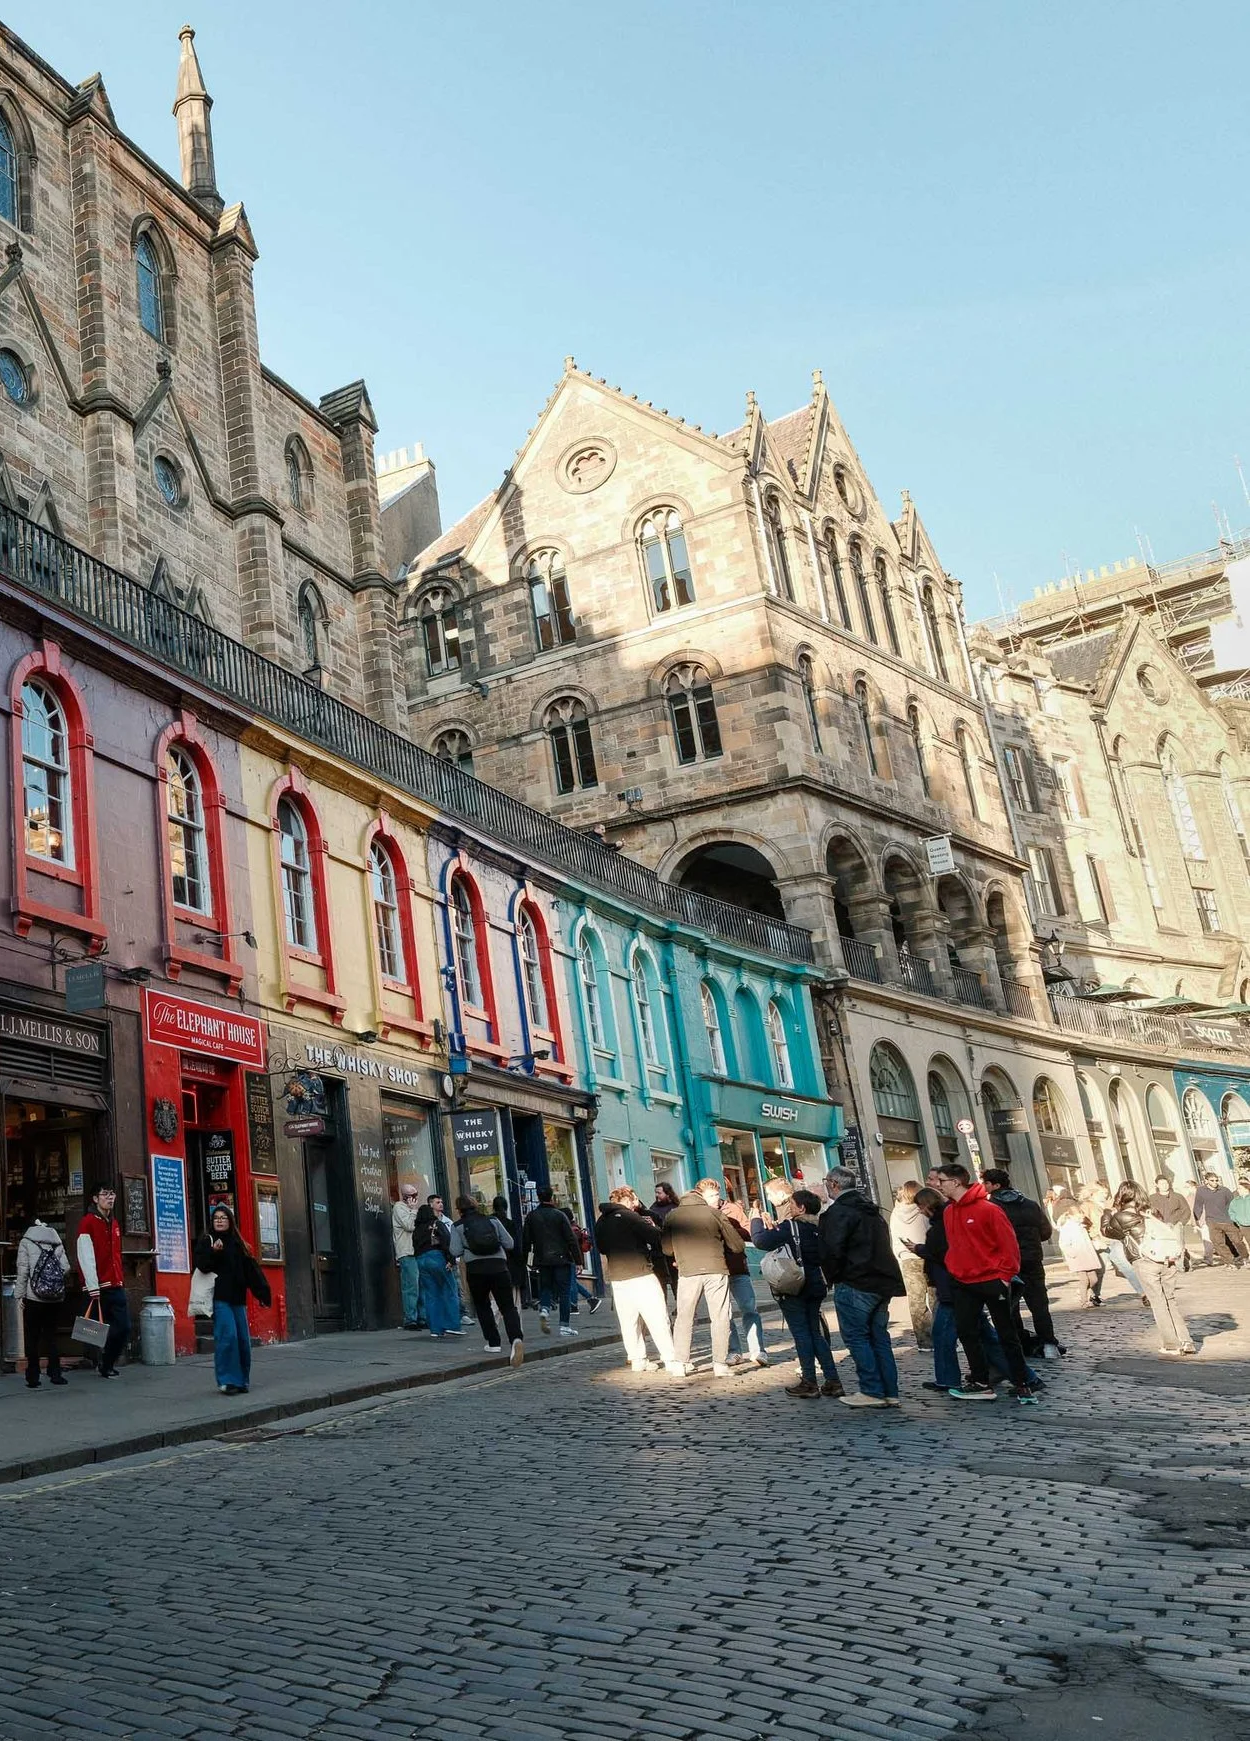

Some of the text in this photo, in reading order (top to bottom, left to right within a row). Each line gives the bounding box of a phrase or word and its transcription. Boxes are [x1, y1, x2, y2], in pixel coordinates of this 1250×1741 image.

[153, 1001, 256, 1048] The ELEPHANT HOUSE
[1195, 1025, 1232, 1042] SCOTTS
[65, 1029, 73, 1046] &
[75, 1031, 99, 1051] SON
[191, 1037, 212, 1048] MAGICAL
[305, 1045, 419, 1087] THE WHISKY SHOP
[761, 1102, 798, 1122] SWISH
[464, 1118, 482, 1126] THE
[456, 1130, 494, 1140] WHISKY
[463, 1143, 489, 1151] SHOP
[206, 1155, 231, 1165] BUTTER
[206, 1164, 232, 1173] SCOTCH
[211, 1172, 228, 1180] BEER
